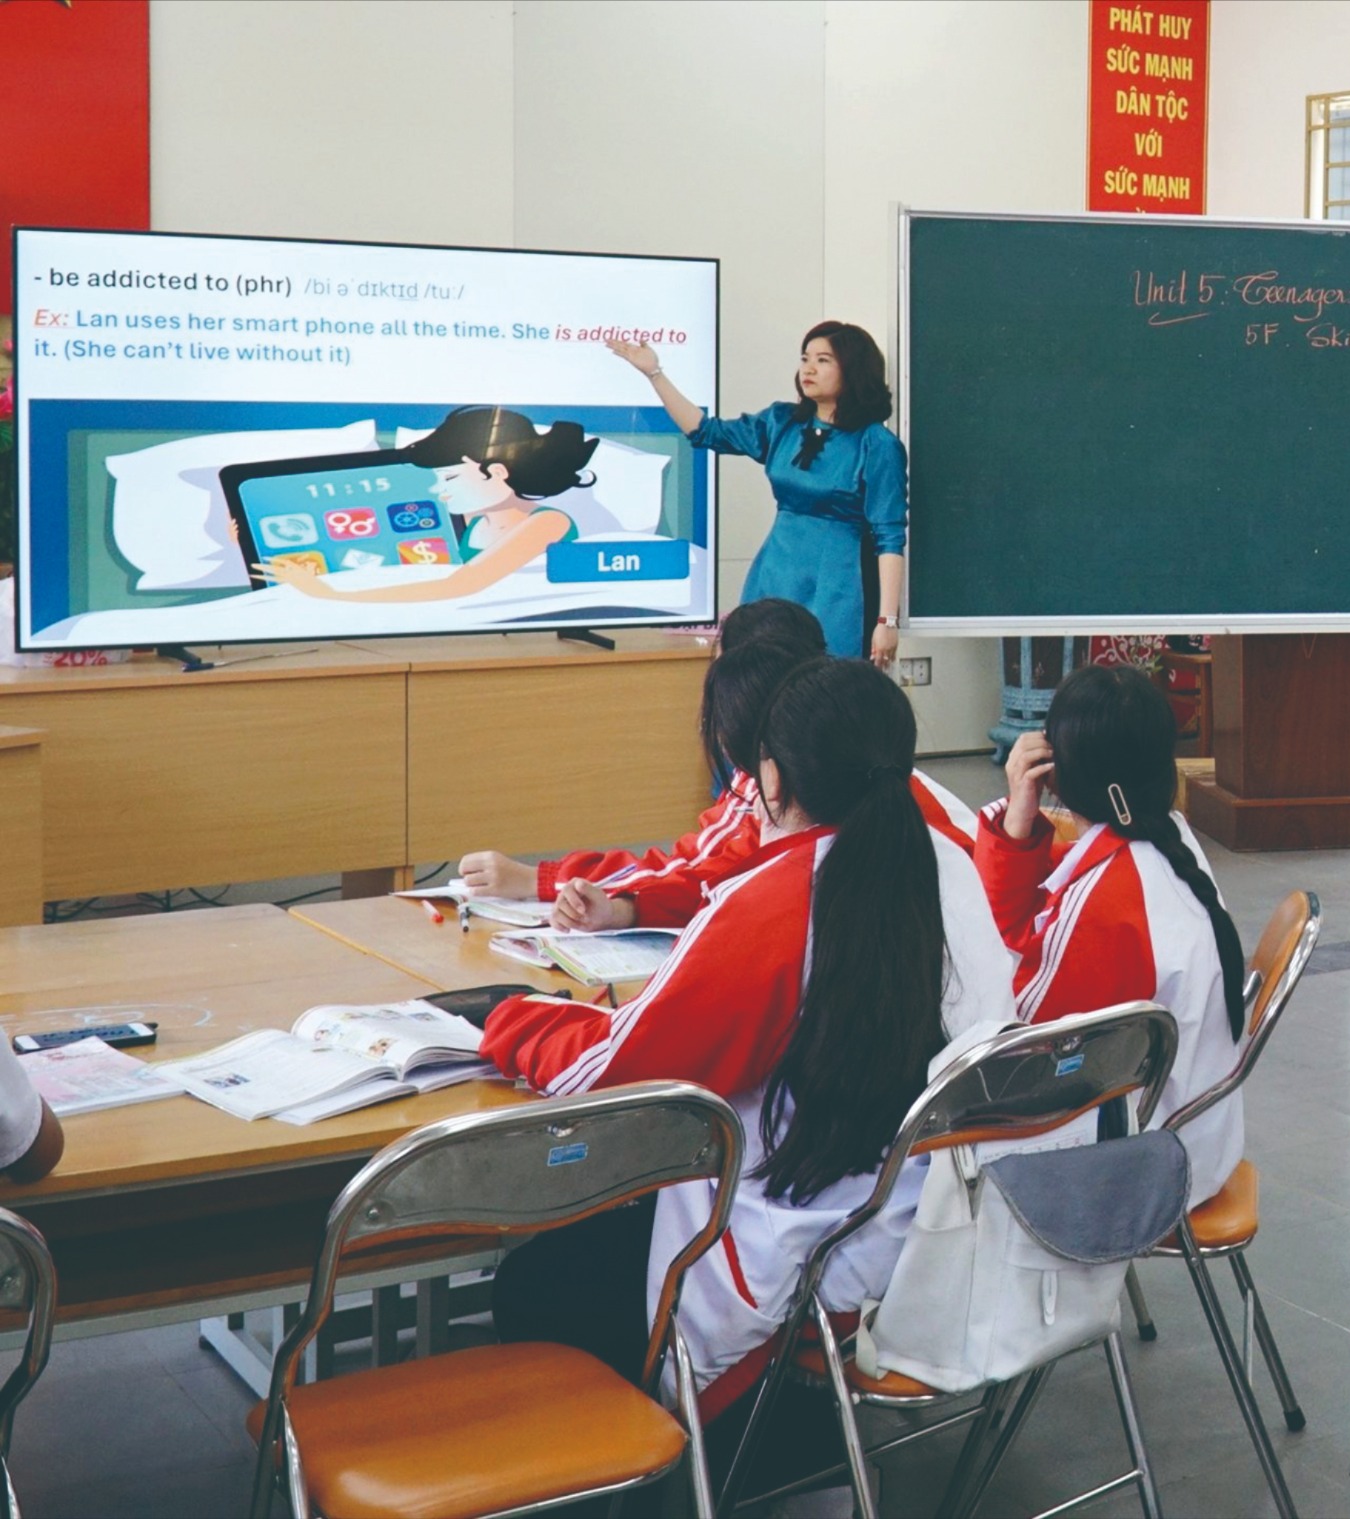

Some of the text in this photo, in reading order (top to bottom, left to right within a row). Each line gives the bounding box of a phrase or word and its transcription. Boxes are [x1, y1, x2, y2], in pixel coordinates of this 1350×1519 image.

[1109, 5, 1193, 41] PHÁT HUY
[1106, 43, 1194, 82] SỨC MẠNH
[1116, 86, 1189, 124] DÂN TỘC
[1134, 128, 1163, 158] VỚI
[1104, 165, 1191, 202] SỨC MẠNH
[49, 267, 80, 288] be
[87, 269, 199, 291] addicted
[205, 273, 230, 292] to
[236, 274, 292, 298] (phr)
[1133, 269, 1189, 306] Unit
[33, 308, 688, 344] Ex: Lan uses her smart phone all the time. She is addicted to
[34, 338, 57, 357] it.
[64, 339, 117, 362] (She
[189, 342, 232, 360] live
[236, 344, 323, 363] without
[329, 345, 351, 367] it)
[597, 551, 641, 572] Lan
